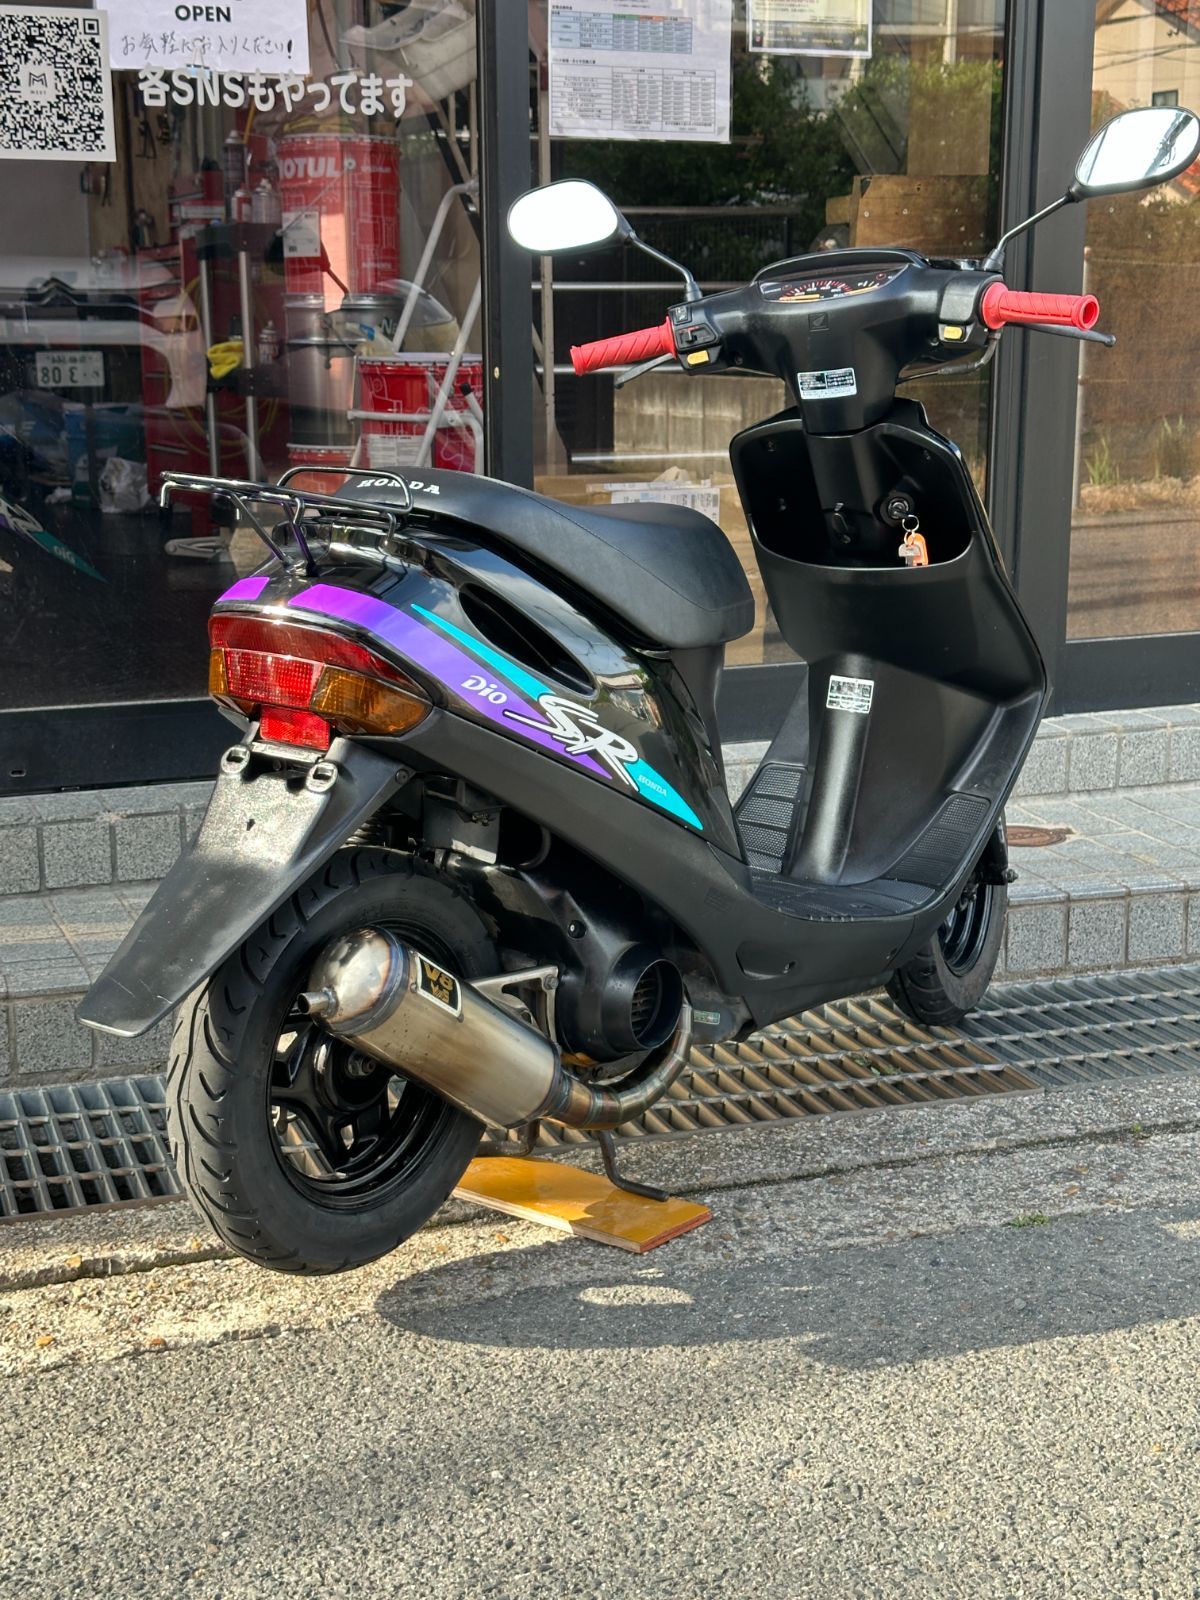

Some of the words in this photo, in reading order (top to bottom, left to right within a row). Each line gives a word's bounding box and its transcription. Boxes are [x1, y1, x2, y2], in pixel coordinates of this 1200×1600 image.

[175, 4, 232, 22] OPEN
[138, 63, 414, 118] 各SNSもやってます
[278, 156, 342, 179] OTUL
[356, 478, 440, 495] HONDA
[460, 675, 508, 705] Dio
[503, 693, 640, 792] SR
[638, 774, 668, 797] HONDA
[423, 961, 454, 991] V8
